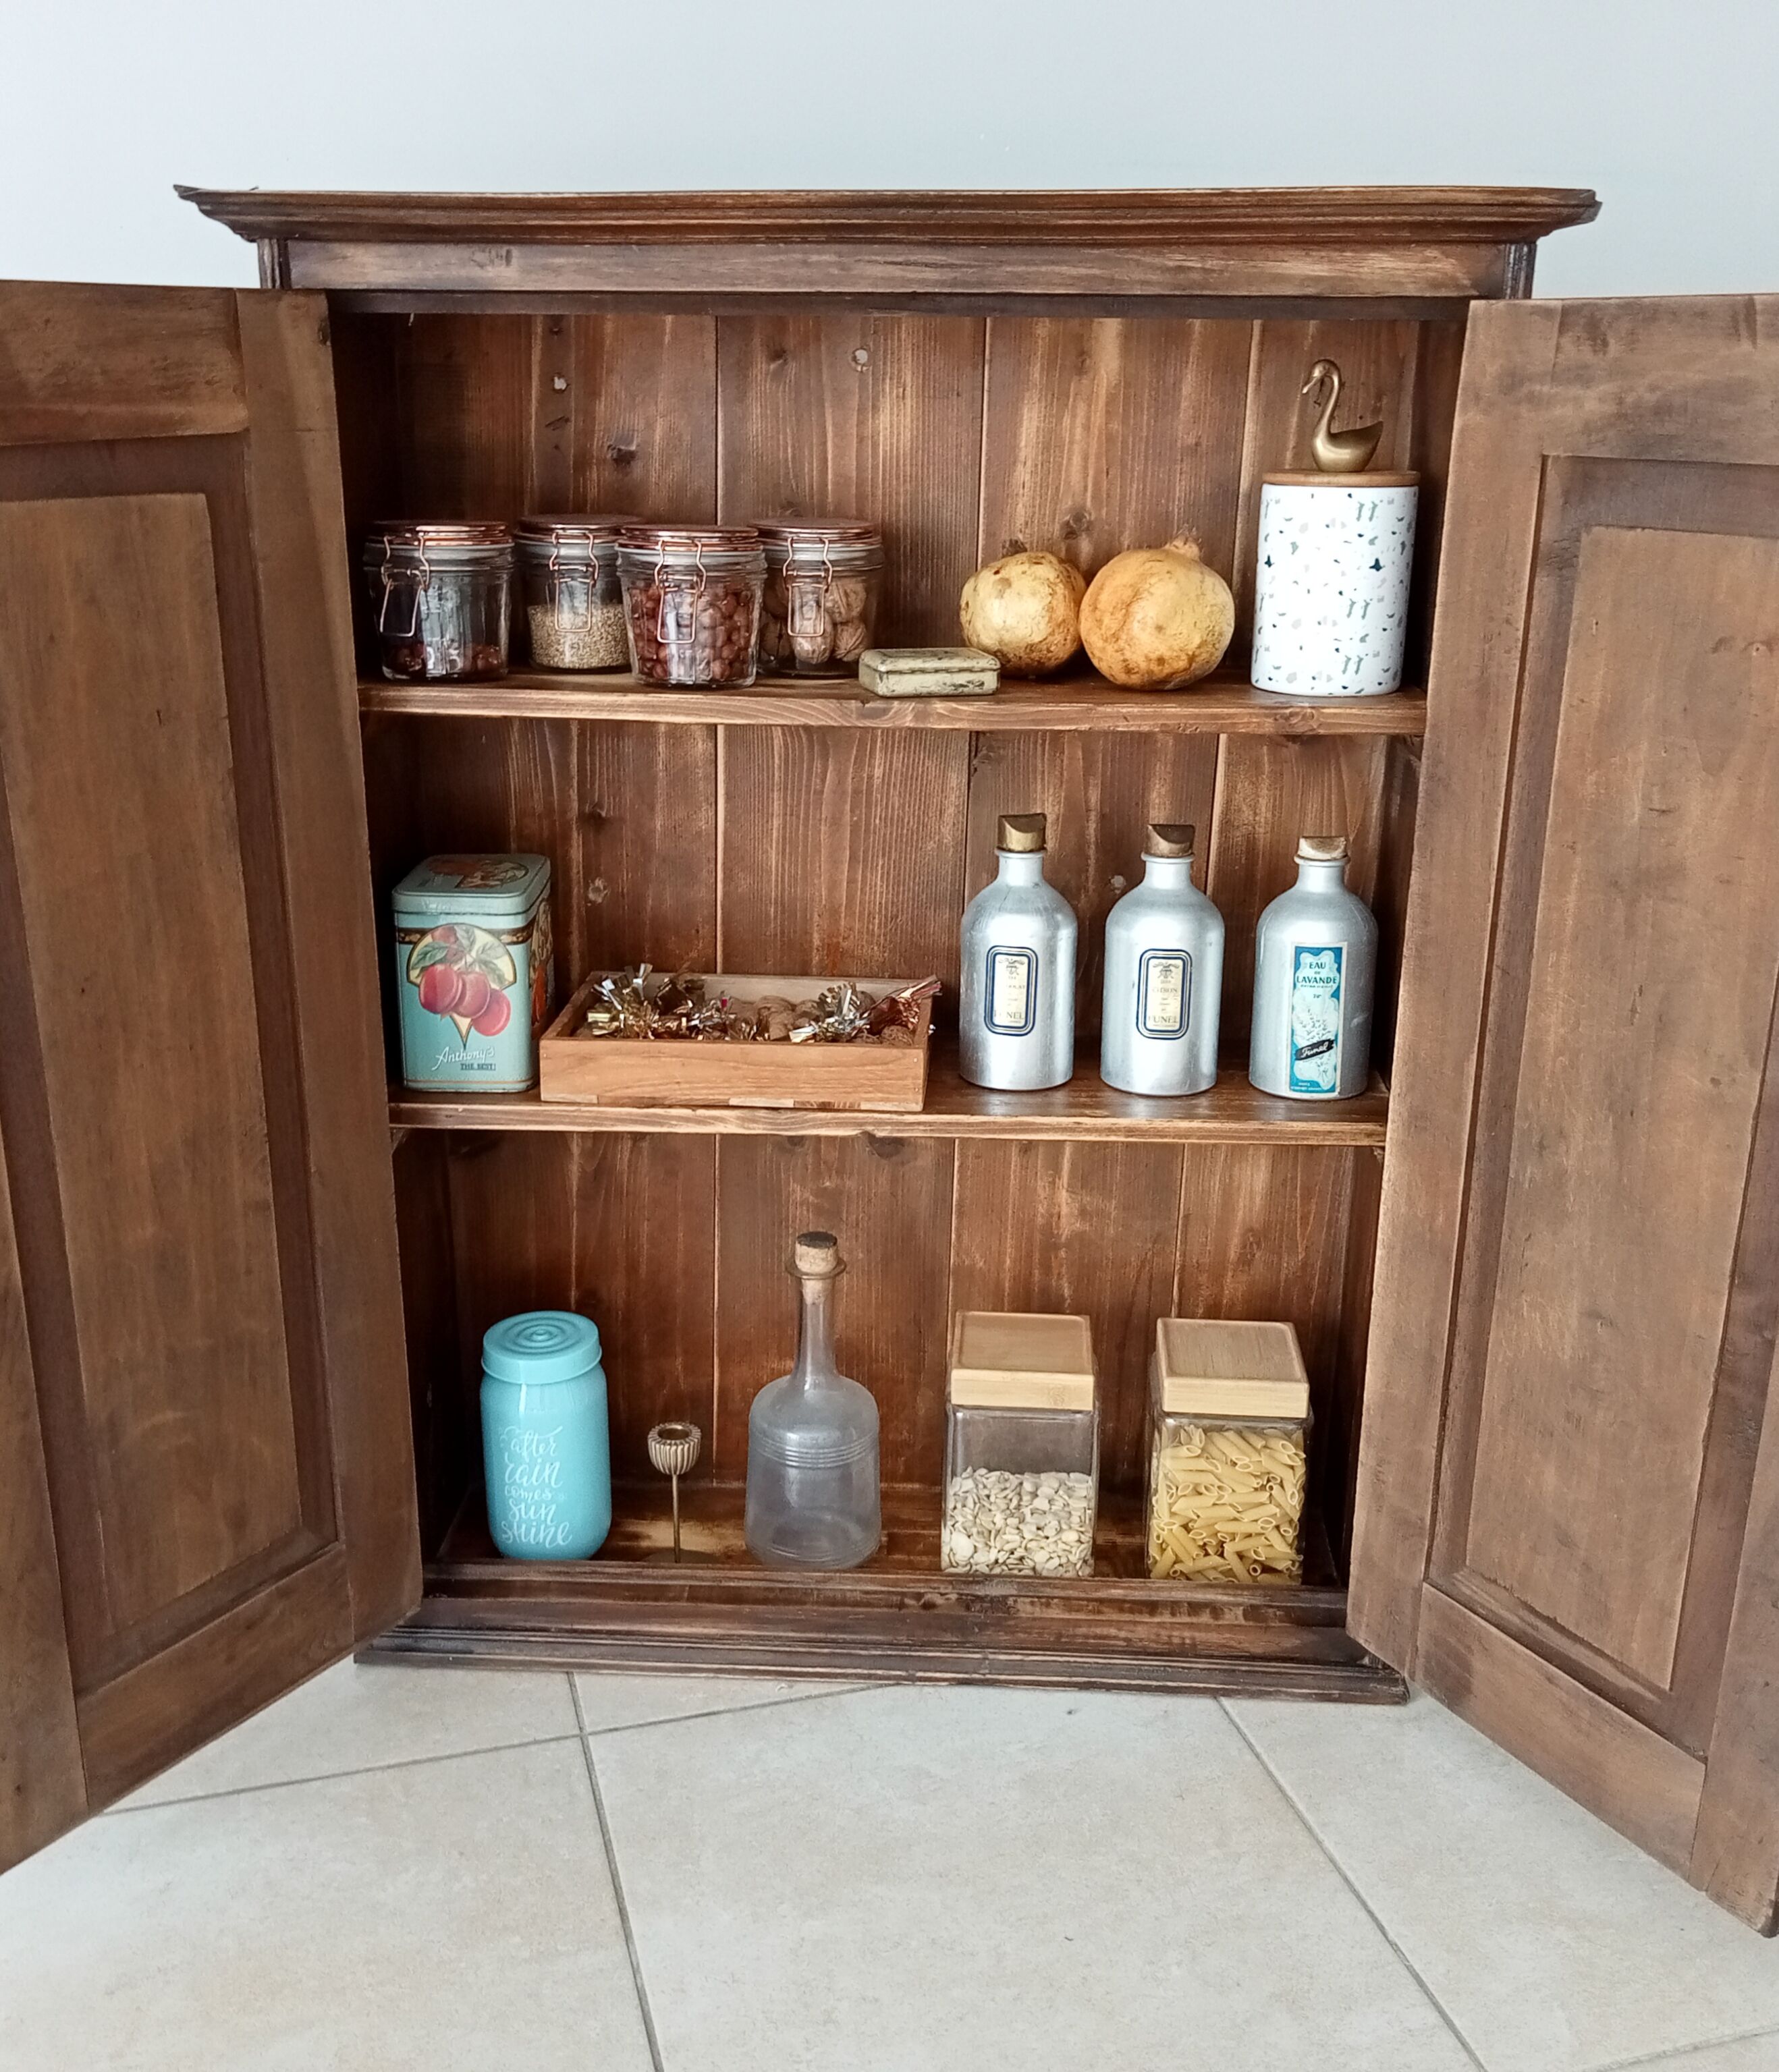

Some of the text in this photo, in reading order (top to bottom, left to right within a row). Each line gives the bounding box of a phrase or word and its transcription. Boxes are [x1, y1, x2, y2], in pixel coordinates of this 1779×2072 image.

[1309, 961, 1327, 970] EAU
[1296, 975, 1338, 984] LAVANDE
[431, 1046, 495, 1071] Anthony's
[510, 1425, 563, 1463] after
[504, 1452, 563, 1488] rain
[505, 1486, 551, 1503] comes
[501, 1520, 573, 1549] shine
